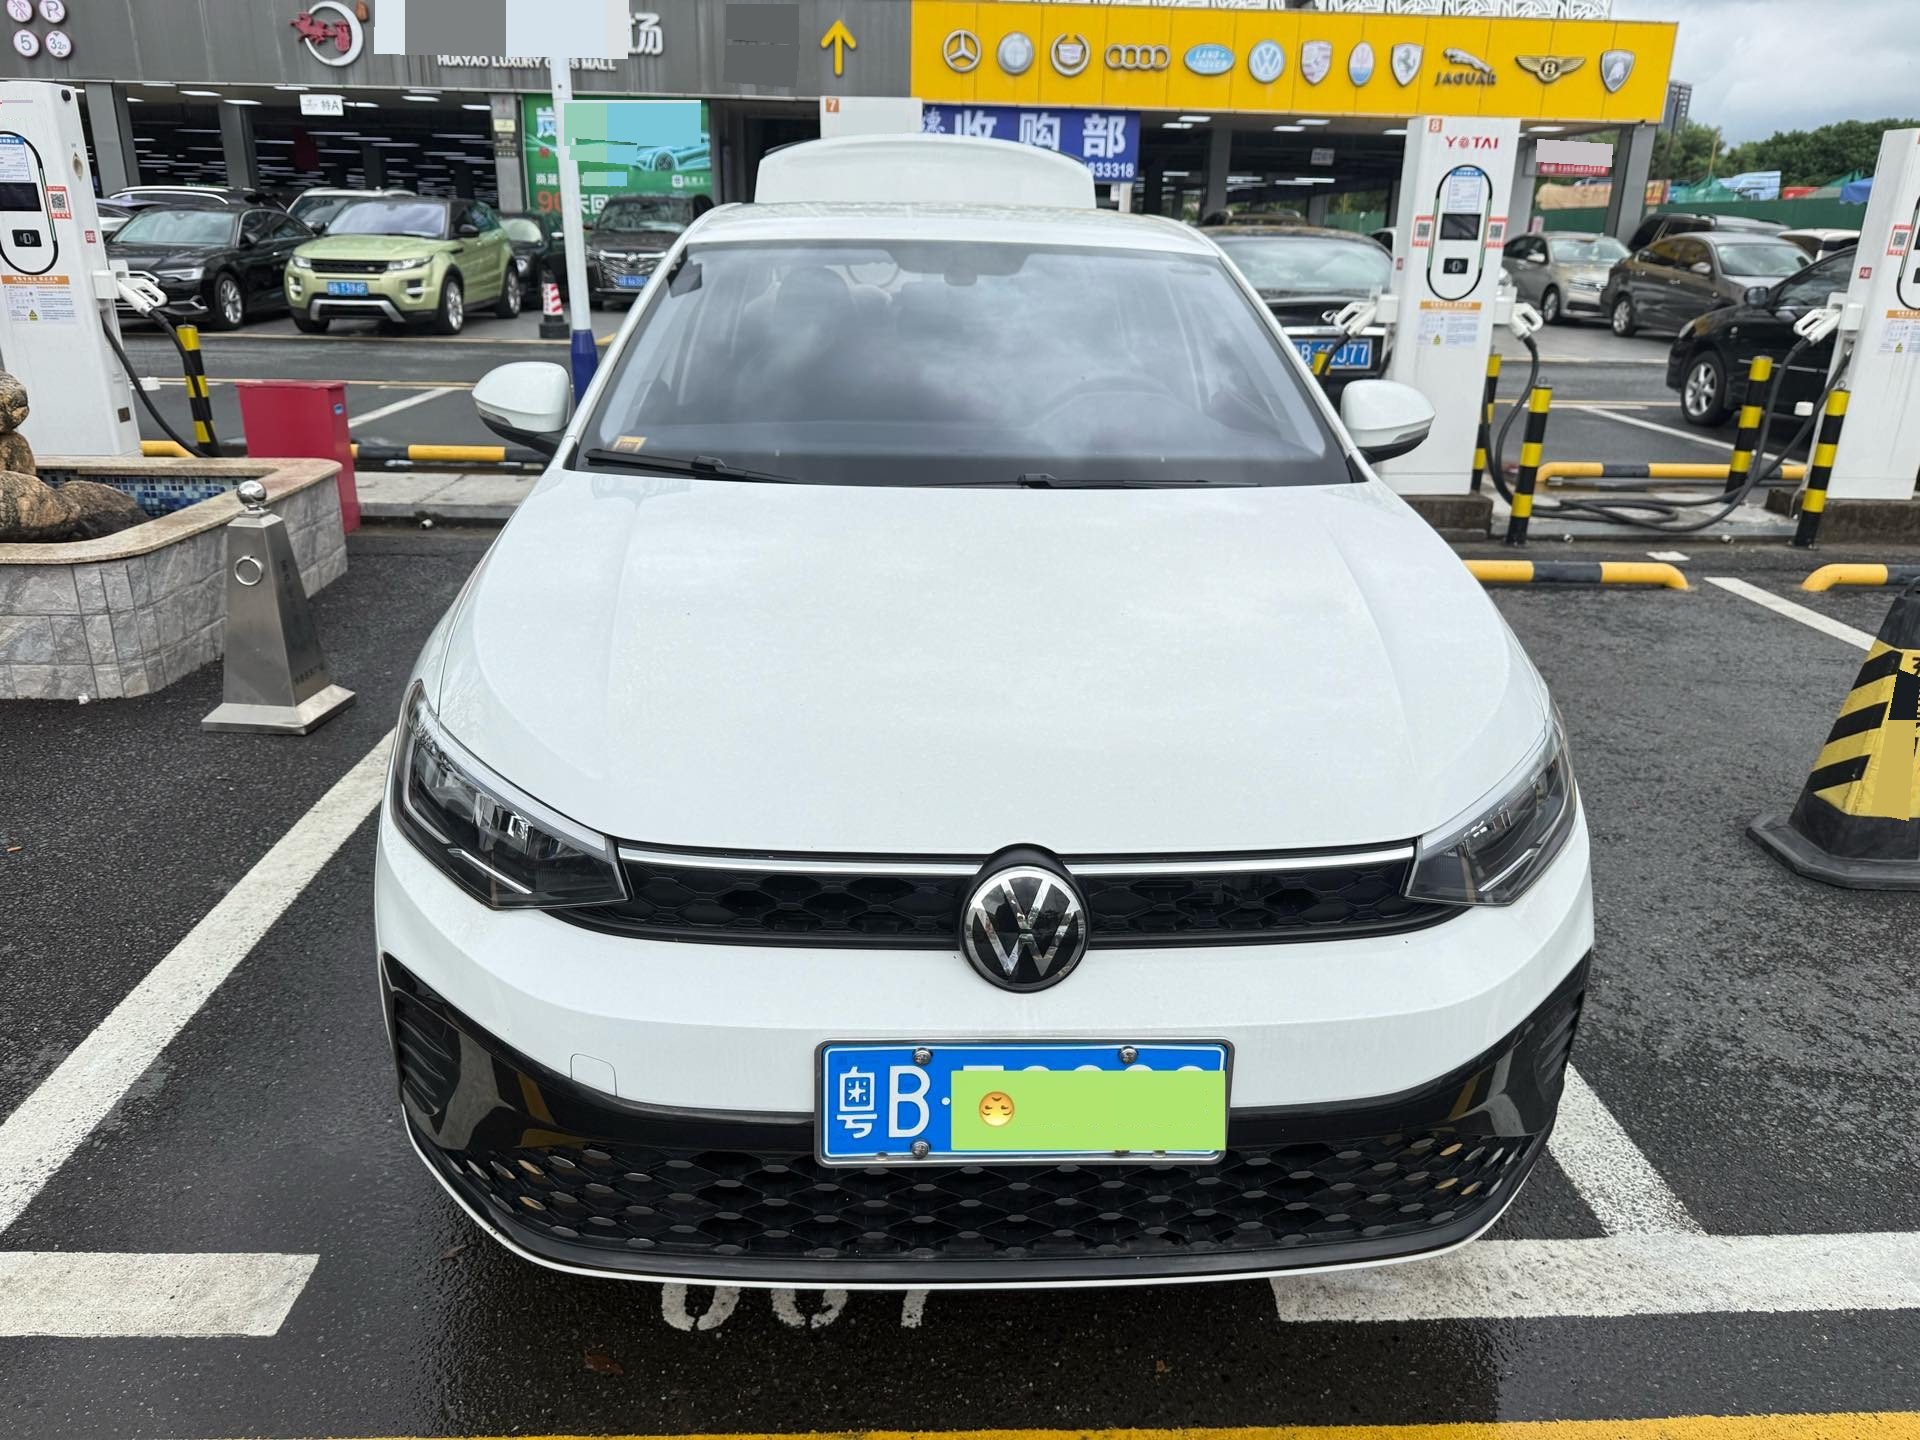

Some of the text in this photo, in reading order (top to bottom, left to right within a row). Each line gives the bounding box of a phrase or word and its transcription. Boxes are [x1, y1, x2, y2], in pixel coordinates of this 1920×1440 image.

[20, 35, 32, 51] 5
[436, 54, 617, 71] HUAYAO LUXURY CS MALL
[1434, 71, 1497, 86] JAGUAR
[828, 98, 839, 111] 7
